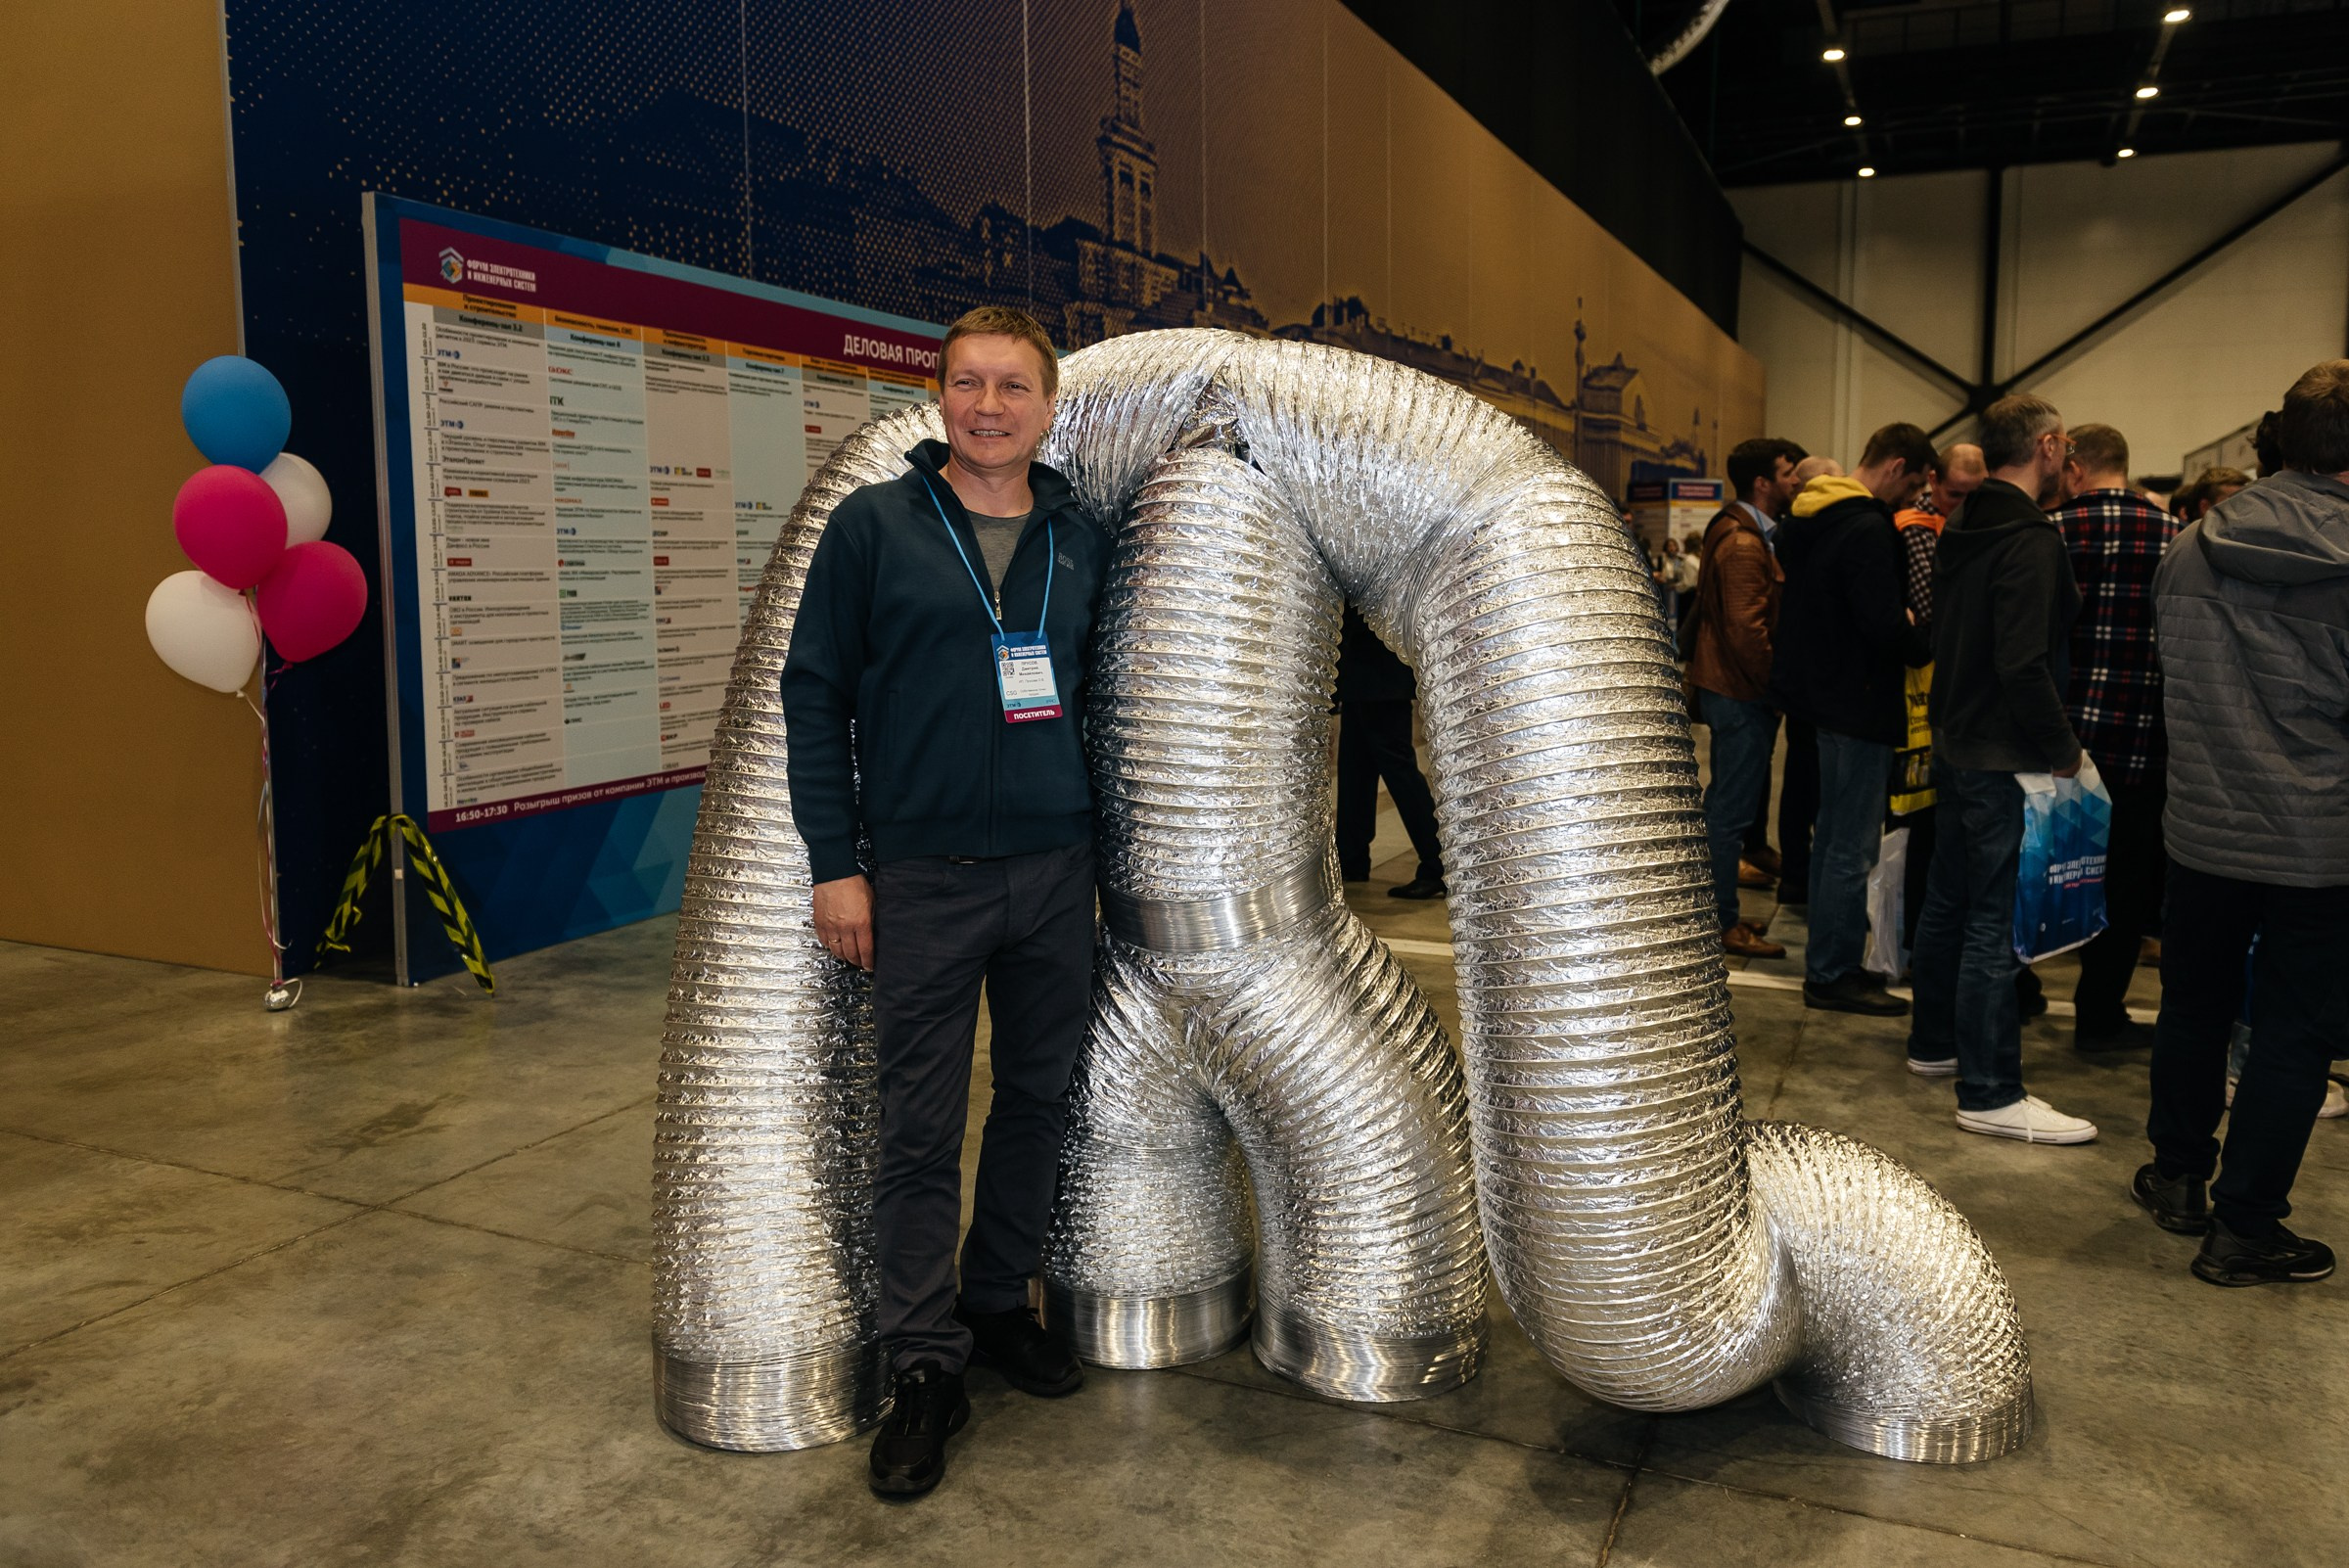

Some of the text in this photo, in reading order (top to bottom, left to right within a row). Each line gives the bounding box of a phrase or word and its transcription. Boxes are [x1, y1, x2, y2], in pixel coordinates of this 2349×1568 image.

[467, 259, 535, 281] ФОРУМ ЭЛЕКТРОТЕХНИКИ
[467, 270, 536, 293] И ИНЖЕНЕРНЫХ СИСТЕМ
[458, 315, 512, 330] Конференц-зал
[844, 334, 940, 369] ДЕЛОВАЯ ПРОГ
[549, 395, 564, 406] ITK
[442, 455, 484, 466] ЭталонПроект
[1013, 710, 1055, 719] ПОСЕТИТЕЛЬ
[455, 805, 508, 822] 16:50-17:30
[514, 796, 561, 811] Розыгрыш
[562, 791, 592, 806] призов
[594, 789, 604, 798] от
[605, 782, 645, 796] компании
[646, 778, 664, 788] ЭТМ
